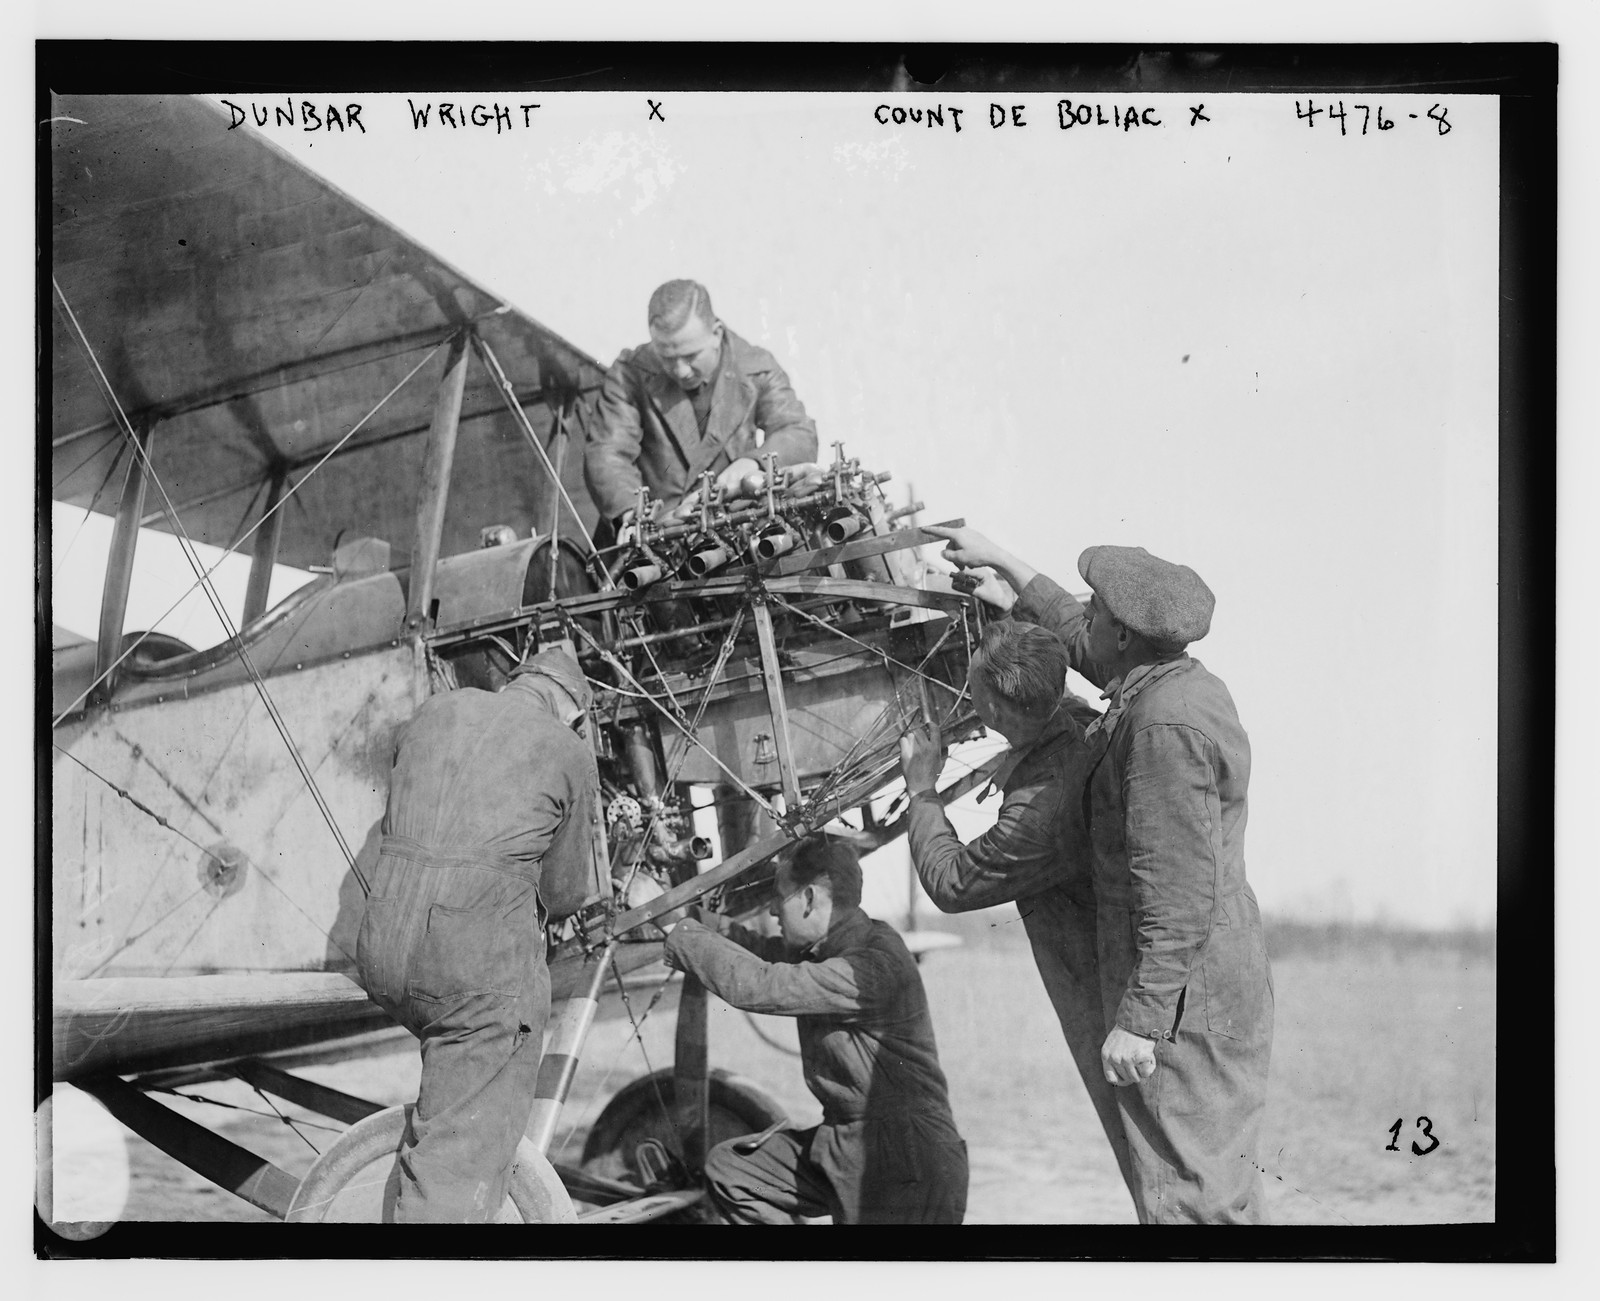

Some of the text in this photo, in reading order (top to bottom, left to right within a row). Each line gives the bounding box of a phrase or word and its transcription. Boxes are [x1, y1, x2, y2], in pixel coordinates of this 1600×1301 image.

[220, 97, 367, 135] DUNBAR
[407, 98, 542, 136] WRIGHT
[873, 103, 964, 133] COUNT
[989, 102, 1028, 130] DE
[1057, 99, 1163, 132] BOLIAC
[1294, 99, 1453, 136] 4476-8
[1385, 1115, 1441, 1157] 13
